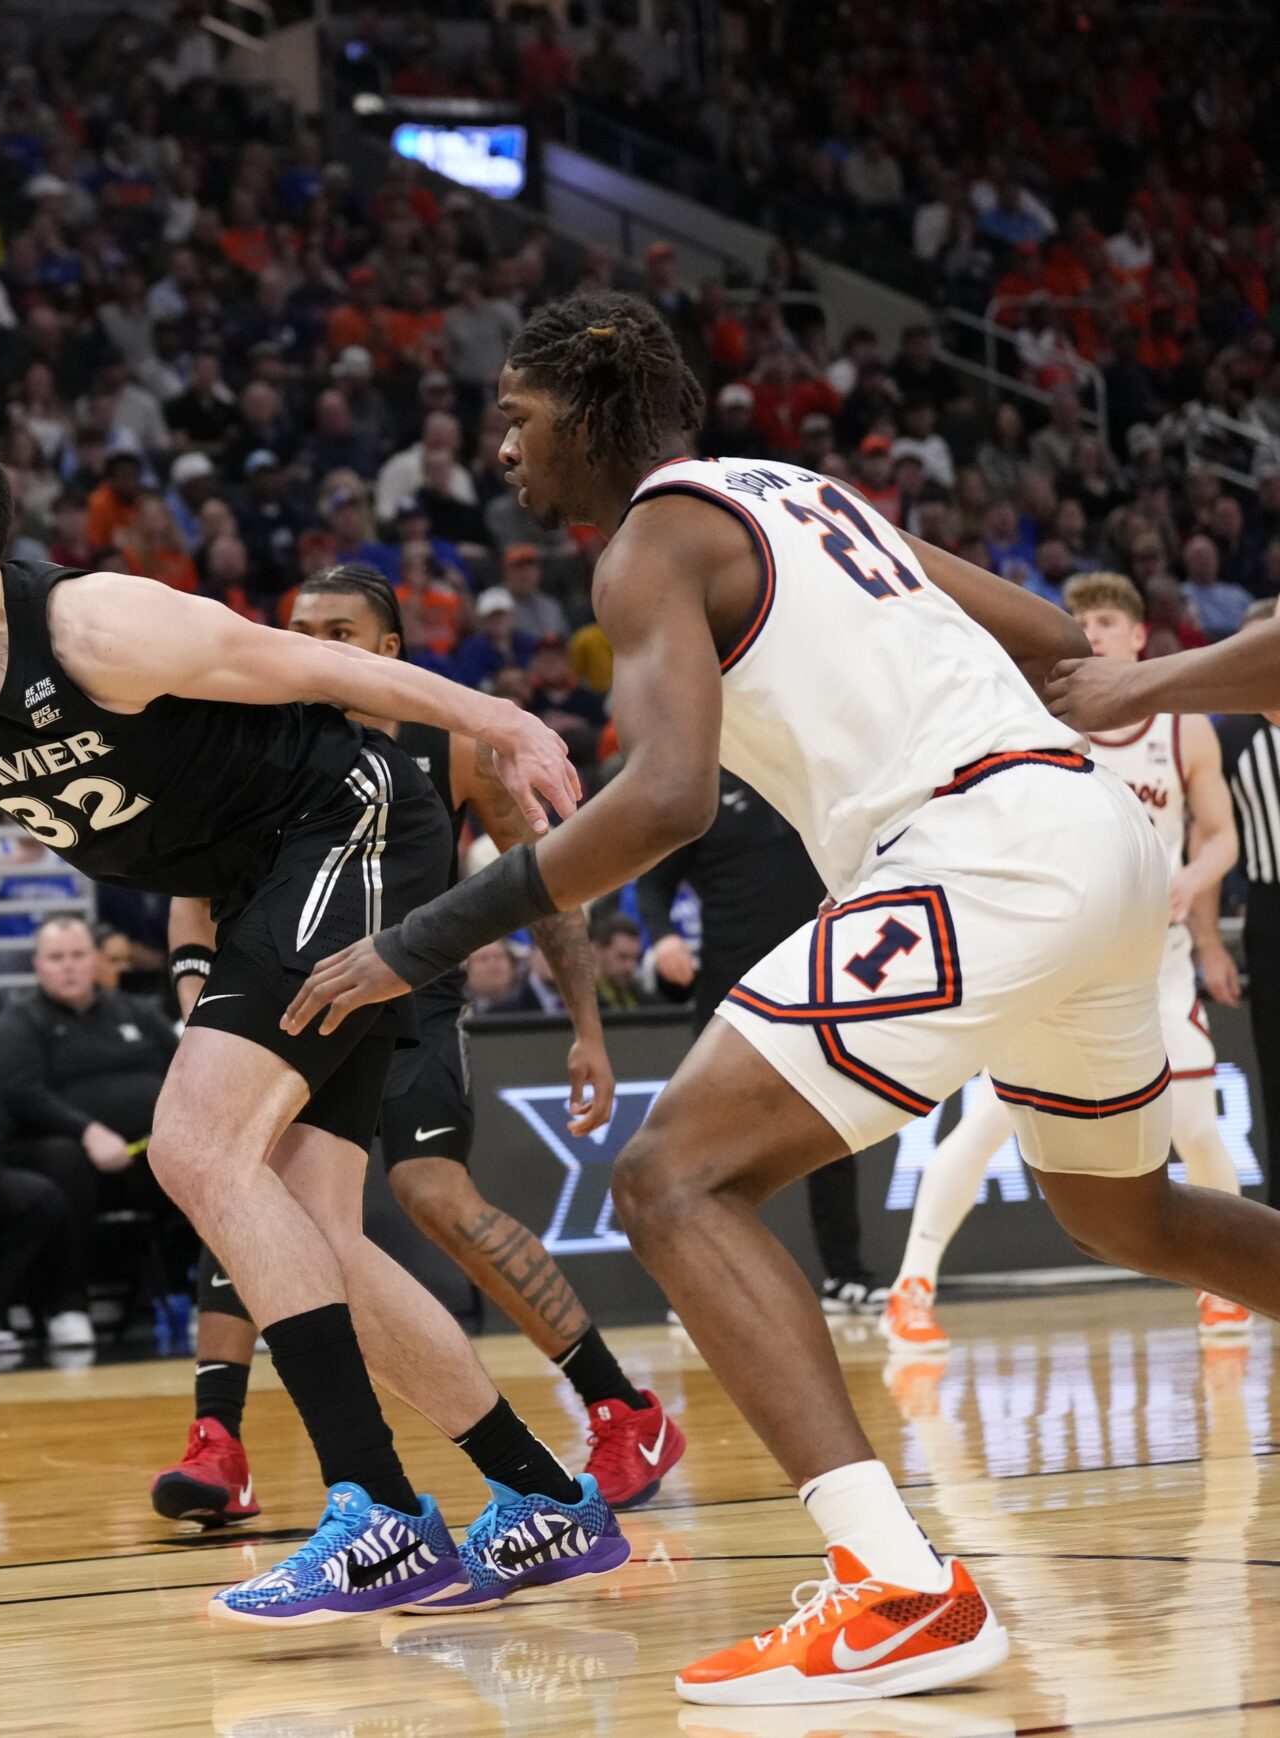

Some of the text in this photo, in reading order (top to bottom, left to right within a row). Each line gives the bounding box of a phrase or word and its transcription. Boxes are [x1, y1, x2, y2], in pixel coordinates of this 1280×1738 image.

[780, 482, 924, 601] 21
[24, 684, 57, 709] CHANGE
[25, 677, 52, 699] BE THE
[30, 704, 51, 721] BIG
[33, 708, 61, 727] EAST
